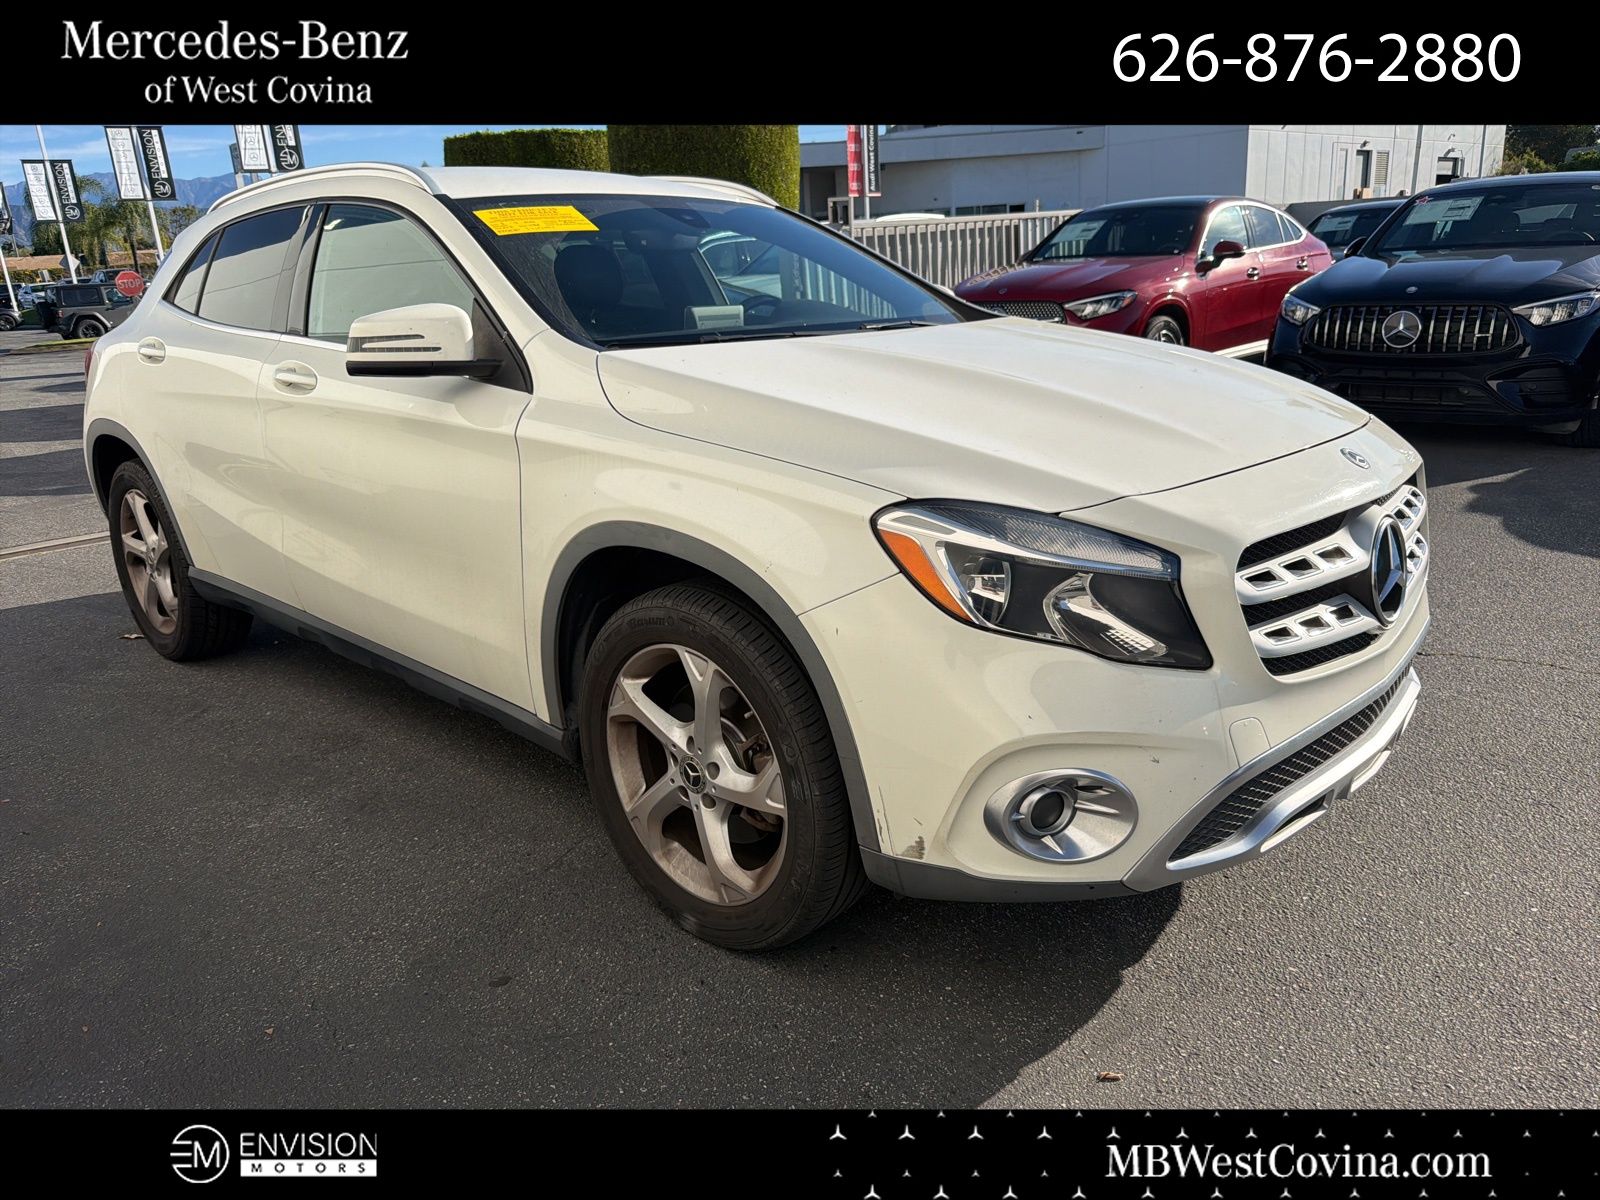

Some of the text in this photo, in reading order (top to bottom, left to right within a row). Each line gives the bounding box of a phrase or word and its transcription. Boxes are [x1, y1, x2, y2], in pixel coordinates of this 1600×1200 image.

[141, 129, 161, 179] ENVISION
[53, 162, 71, 204] ENVISION
[119, 278, 141, 289] STOP
